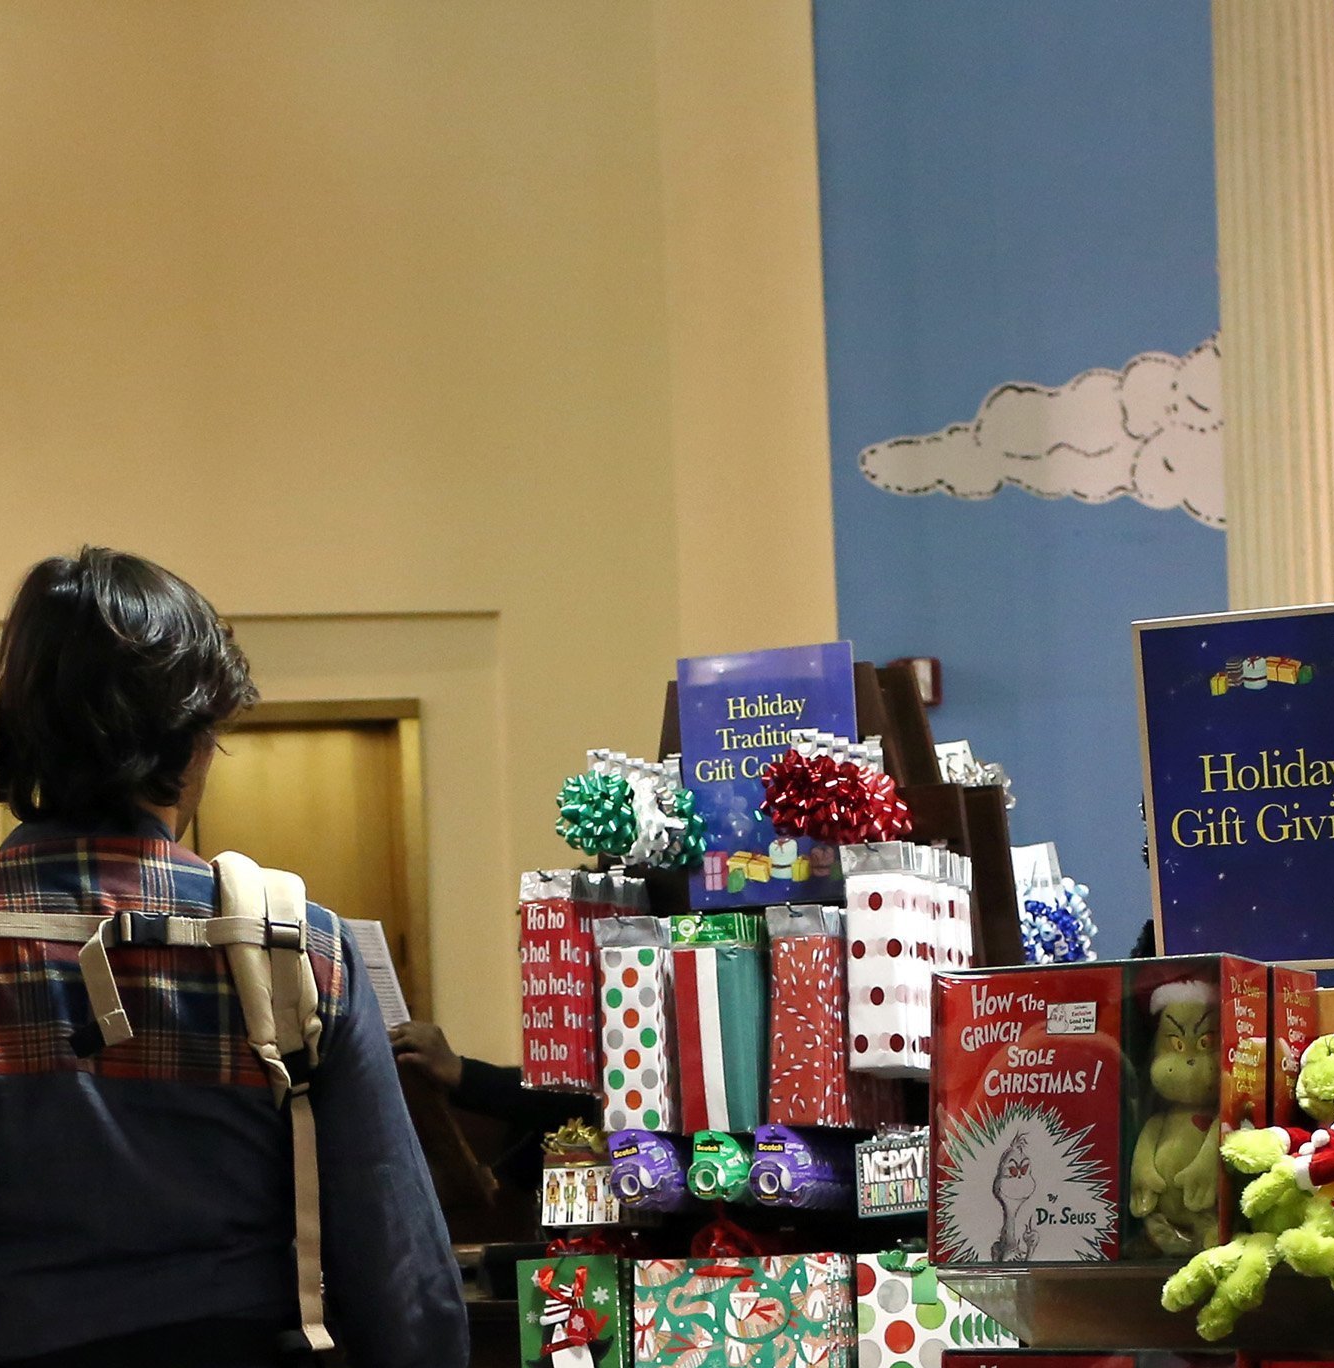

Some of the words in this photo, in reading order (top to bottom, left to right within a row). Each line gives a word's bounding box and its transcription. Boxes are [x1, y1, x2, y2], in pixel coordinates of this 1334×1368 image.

[727, 693, 805, 720] Holiday
[715, 724, 793, 750] Traditio
[695, 758, 735, 782] Gift
[1171, 806, 1248, 848] Gift
[527, 907, 544, 930] Ho
[547, 907, 565, 929] ho
[529, 941, 550, 963] ho!
[1017, 994, 1045, 1012] The
[533, 1007, 553, 1028] ho!
[961, 1022, 1022, 1052] GRINCH
[530, 1040, 547, 1061] Ho
[550, 1040, 567, 1060] ho
[1007, 1046, 1055, 1068] STOLE
[613, 1147, 638, 1159] Scotch
[696, 1144, 719, 1152] Scotch
[758, 1143, 783, 1152] Scotch
[862, 1146, 925, 1184] MERRY
[863, 1178, 928, 1207] CHRISTMAS
[1036, 1208, 1057, 1226] Dr.
[1060, 1206, 1097, 1225] Seuss
